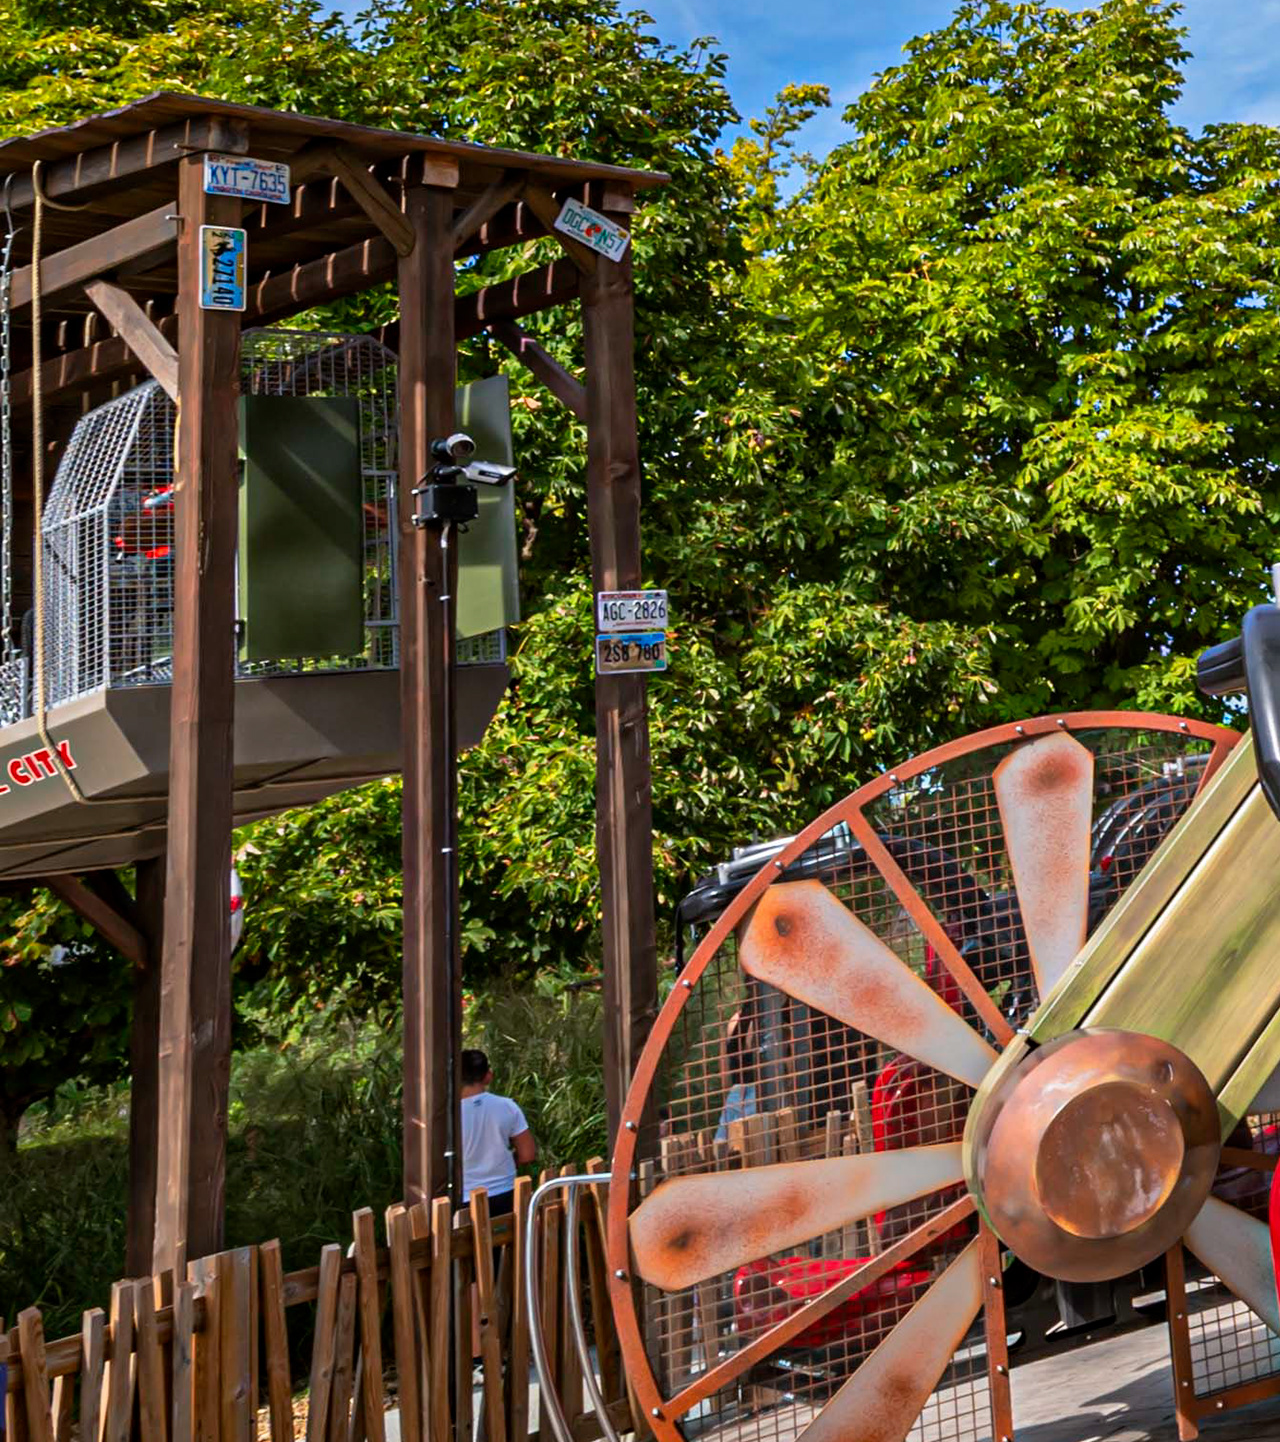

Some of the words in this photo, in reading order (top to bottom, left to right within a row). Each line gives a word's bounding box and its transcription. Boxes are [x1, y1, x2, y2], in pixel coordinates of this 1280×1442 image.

[210, 164, 286, 194] KYT-7635
[603, 600, 666, 622] AGC-2826
[7, 740, 78, 787] CITY
